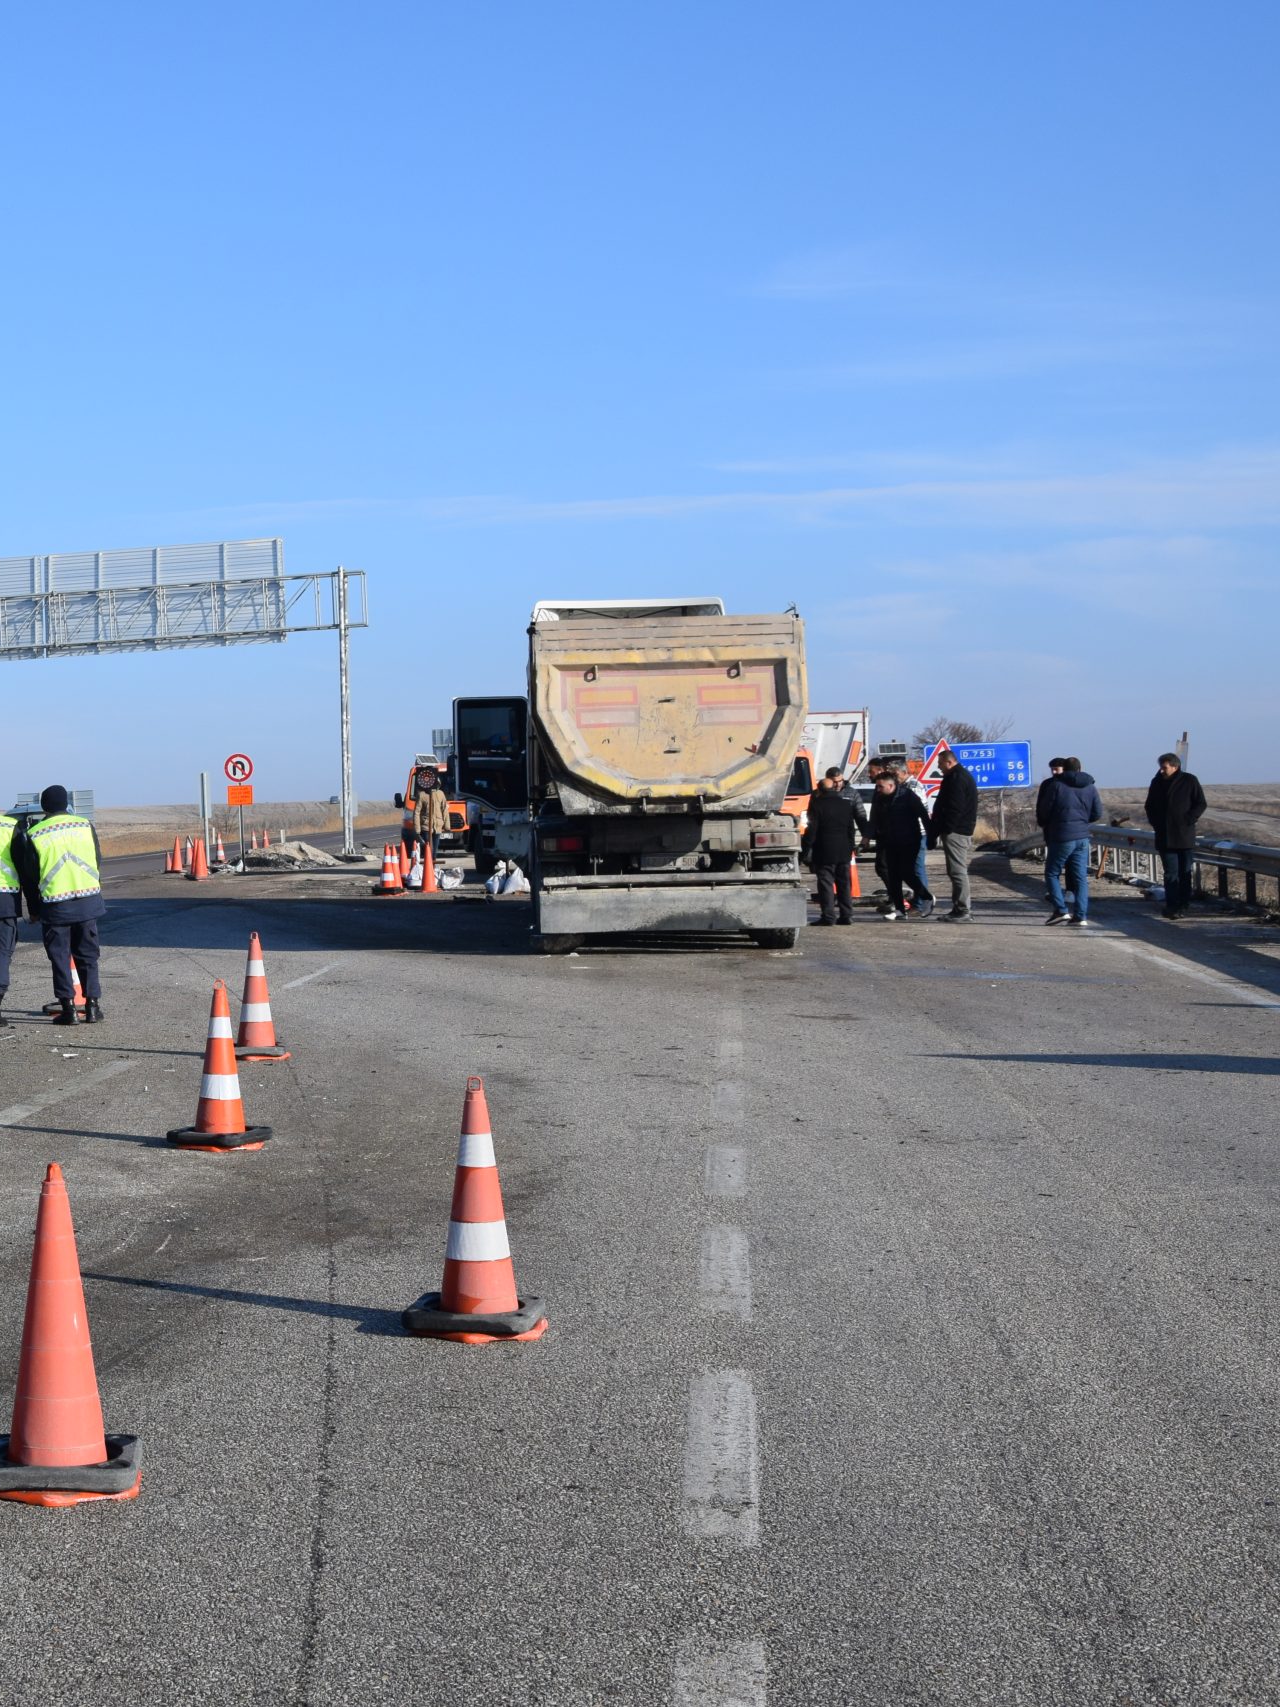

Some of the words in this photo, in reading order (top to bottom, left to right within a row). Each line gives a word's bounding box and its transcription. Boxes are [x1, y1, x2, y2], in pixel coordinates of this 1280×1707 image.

[962, 750, 993, 758] D.753
[1007, 761, 1024, 769] 56
[1008, 773, 1024, 782] 88
